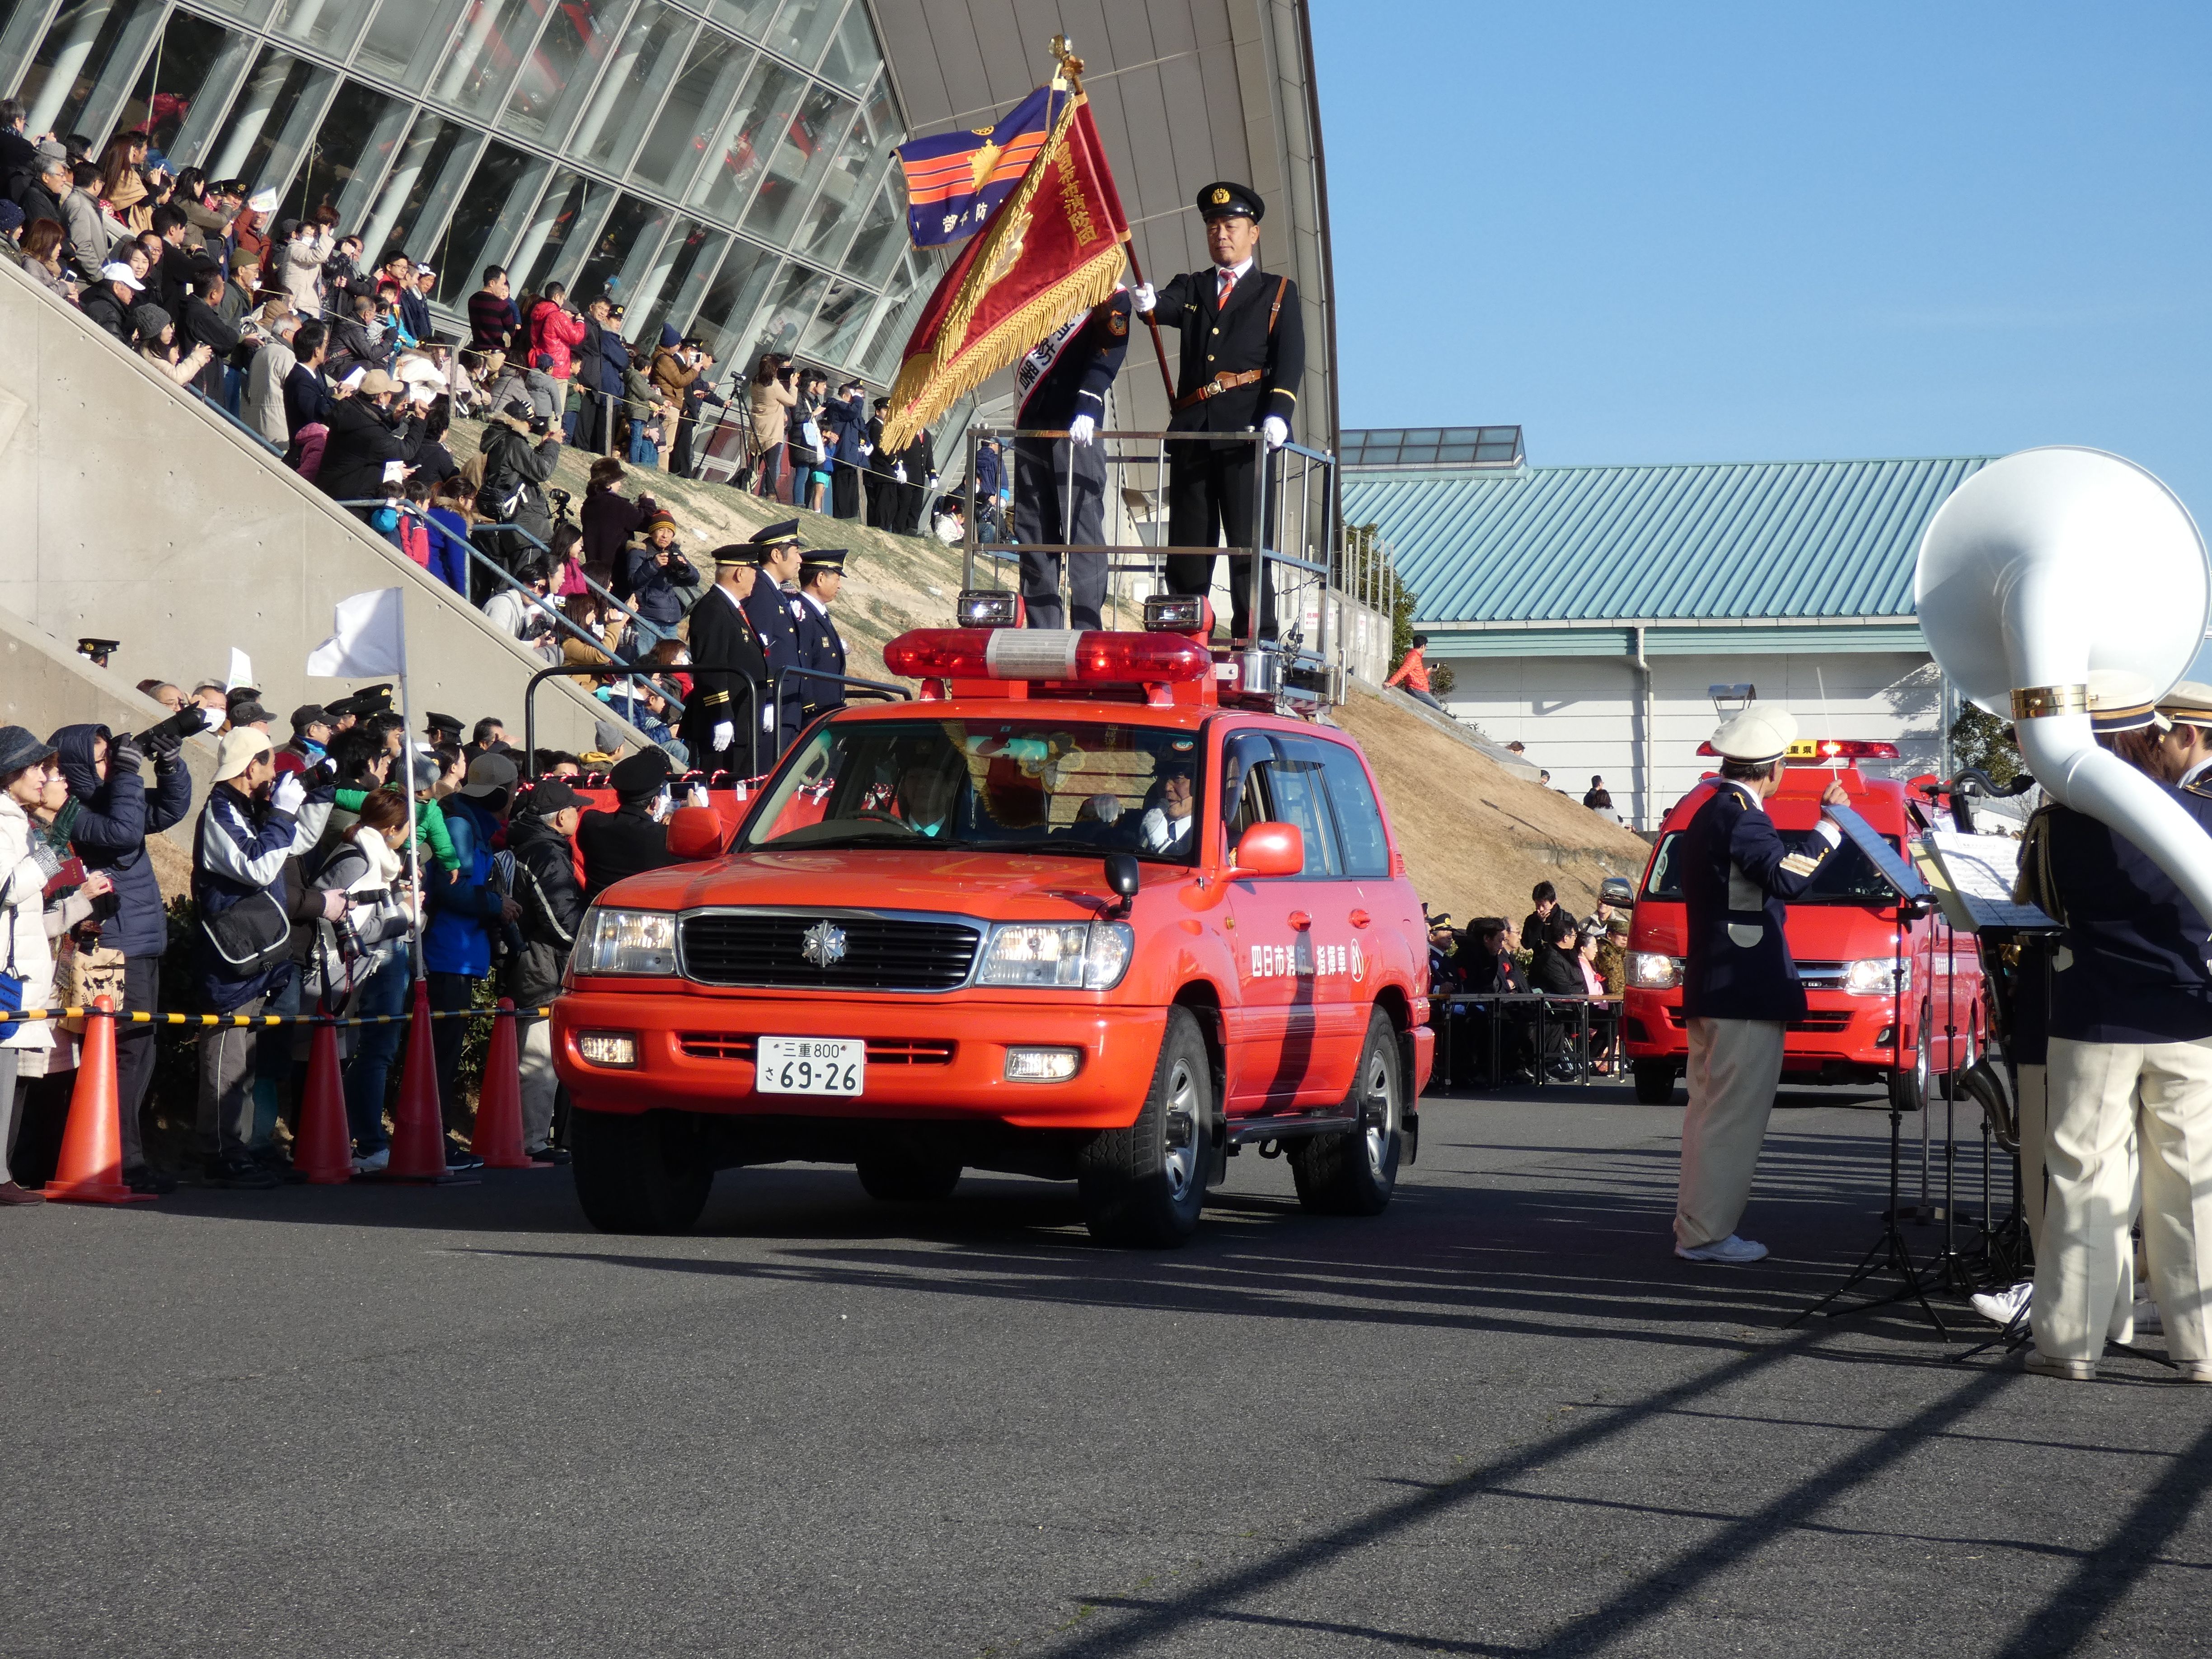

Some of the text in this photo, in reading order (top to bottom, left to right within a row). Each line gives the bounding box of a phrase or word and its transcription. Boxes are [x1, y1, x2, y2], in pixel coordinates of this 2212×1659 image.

[1054, 141, 1097, 247] 四日市市消防団
[1786, 745, 1812, 754] 重県
[765, 1061, 857, 1091] さ 69-26
